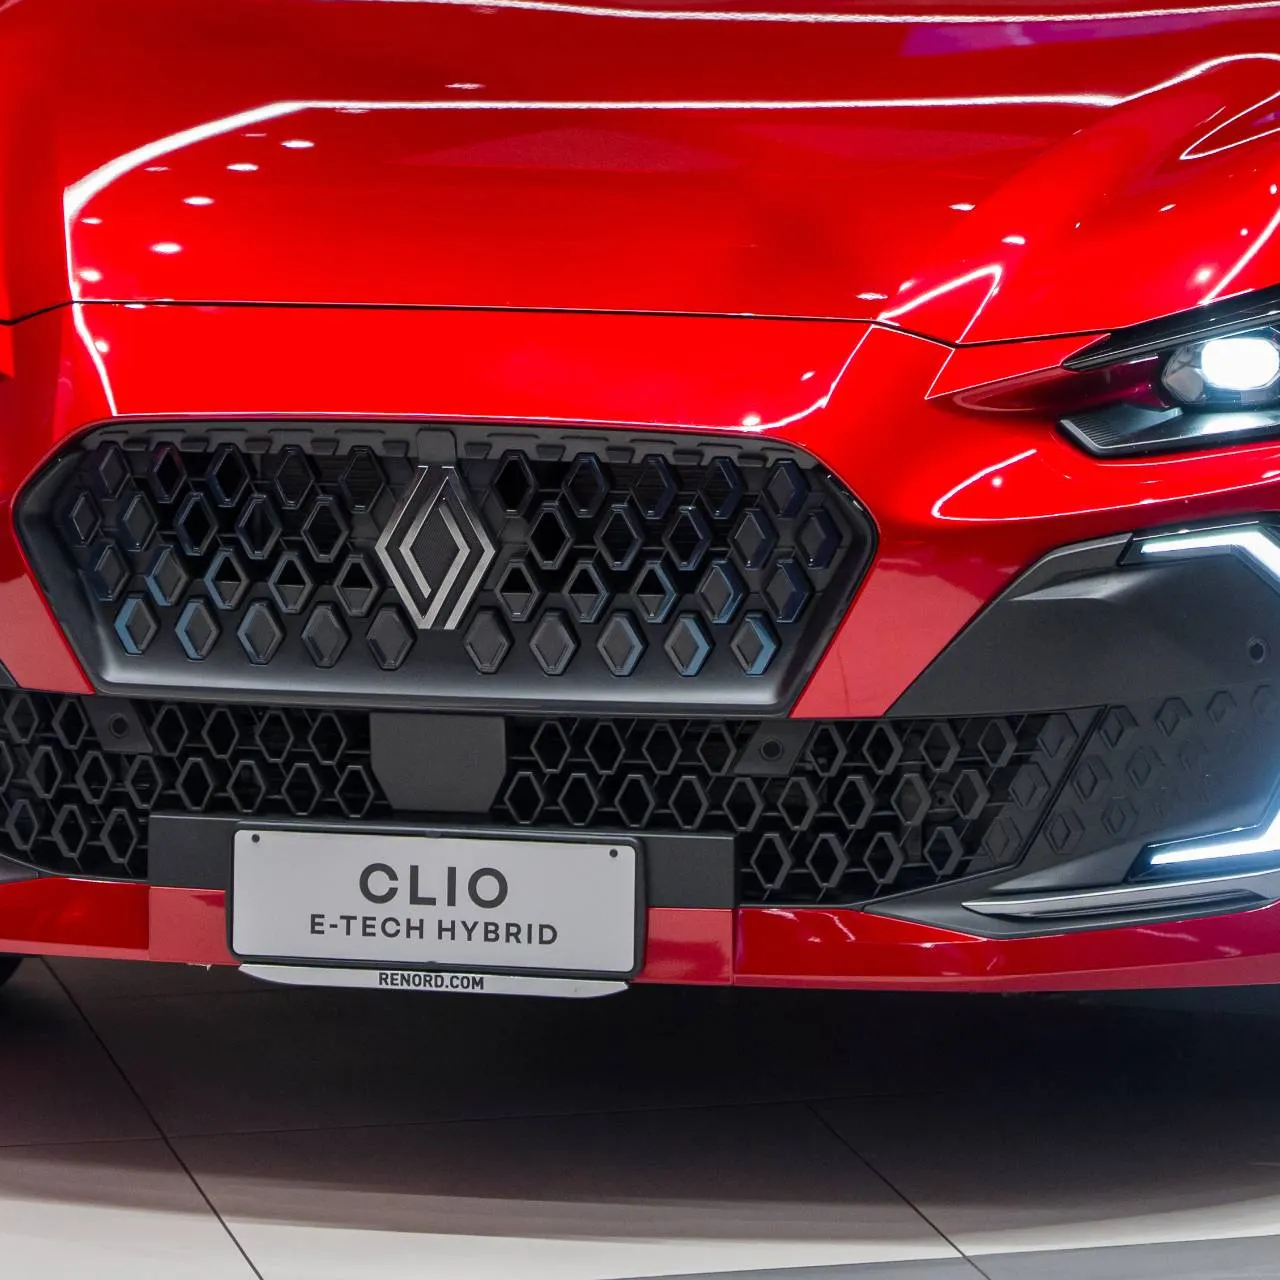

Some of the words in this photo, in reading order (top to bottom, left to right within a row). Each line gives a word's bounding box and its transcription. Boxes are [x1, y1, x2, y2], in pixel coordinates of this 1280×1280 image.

[358, 862, 509, 909] CLIO
[310, 913, 424, 939] E-TECH
[437, 919, 558, 945] HYBRID
[378, 971, 485, 990] RENORD.COM
